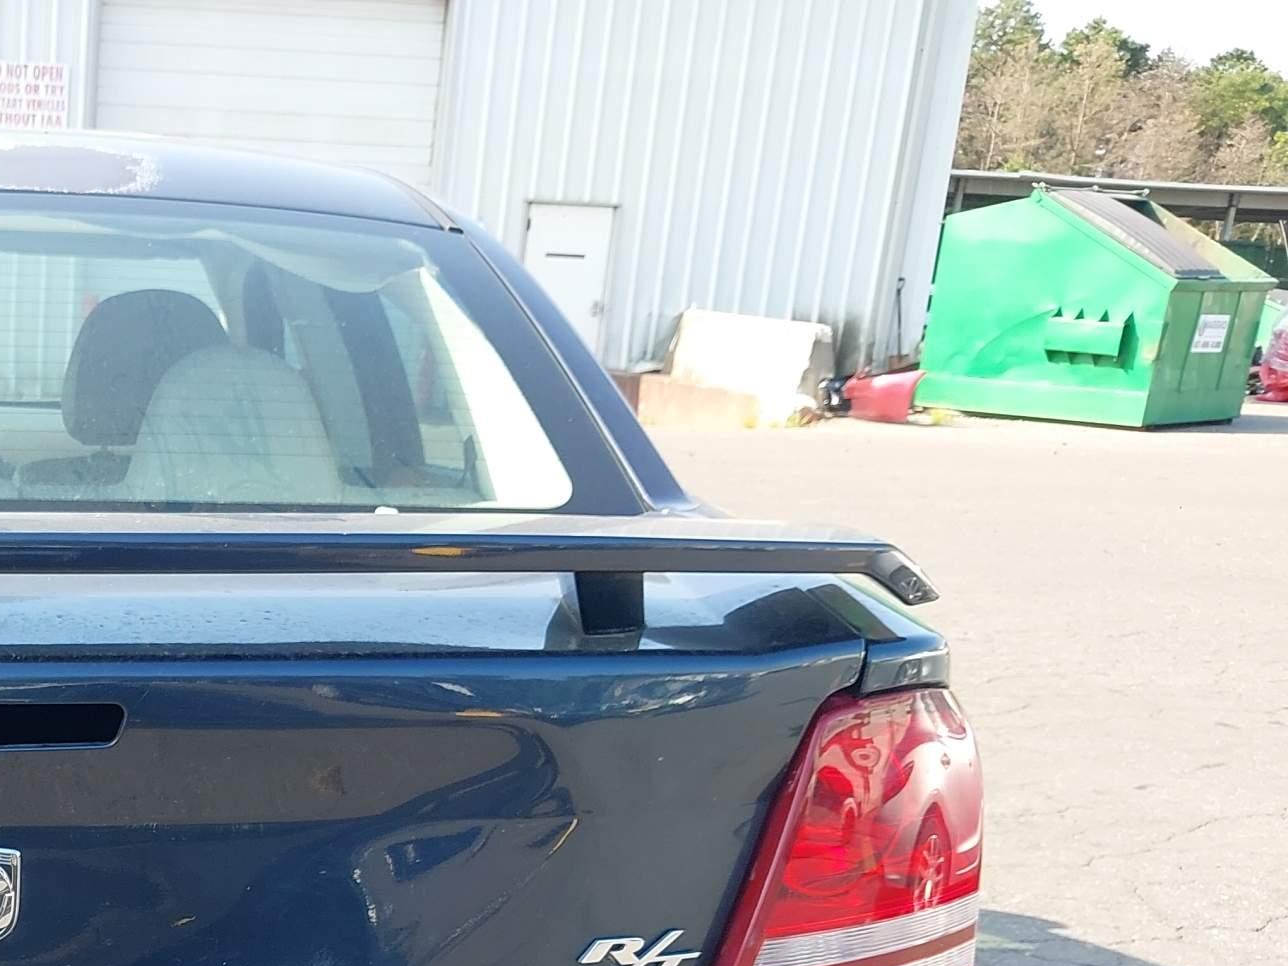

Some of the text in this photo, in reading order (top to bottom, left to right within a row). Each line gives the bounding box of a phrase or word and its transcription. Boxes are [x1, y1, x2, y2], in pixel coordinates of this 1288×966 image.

[6, 63, 28, 80] NOT
[33, 65, 64, 81] OPEN
[25, 84, 40, 95] OR
[44, 84, 64, 96] TRY
